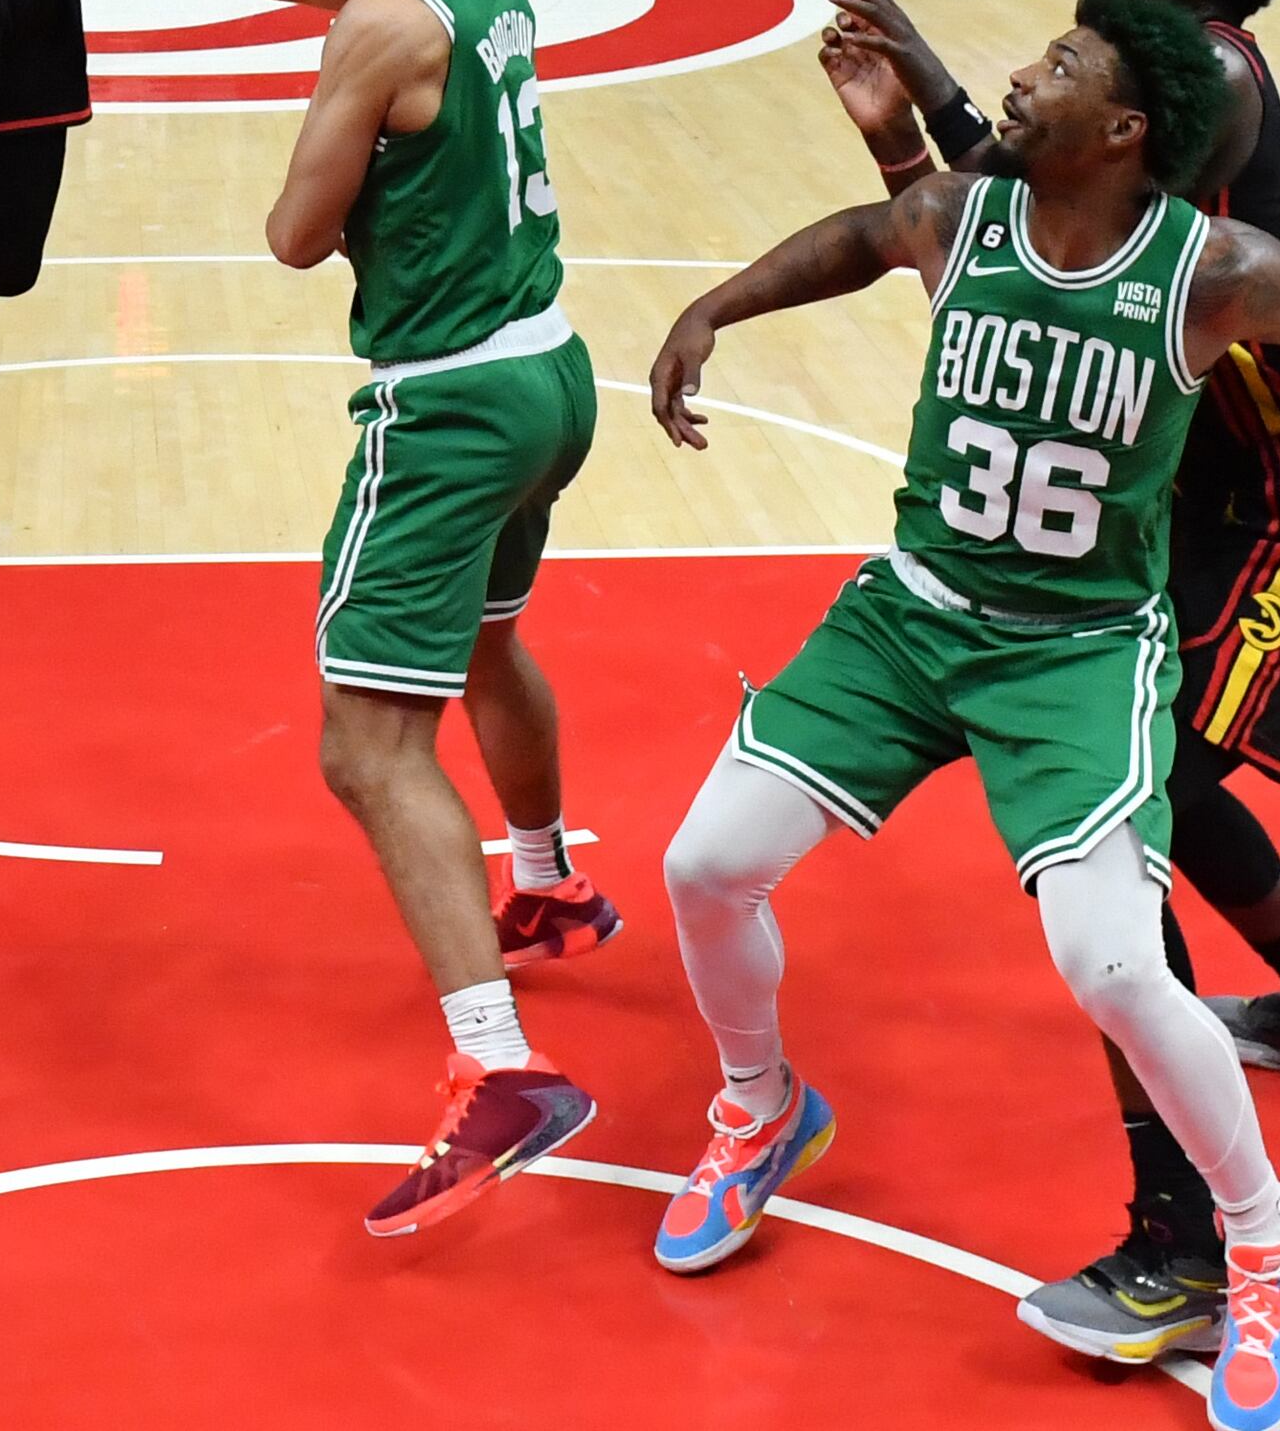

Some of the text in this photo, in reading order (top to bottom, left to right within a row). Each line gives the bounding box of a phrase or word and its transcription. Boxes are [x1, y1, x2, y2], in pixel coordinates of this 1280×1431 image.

[982, 224, 1005, 248] 6
[1117, 281, 1162, 307] VISTA
[1113, 300, 1160, 325] PRINT
[936, 310, 1156, 446] BOSTON
[939, 415, 1111, 559] 36
